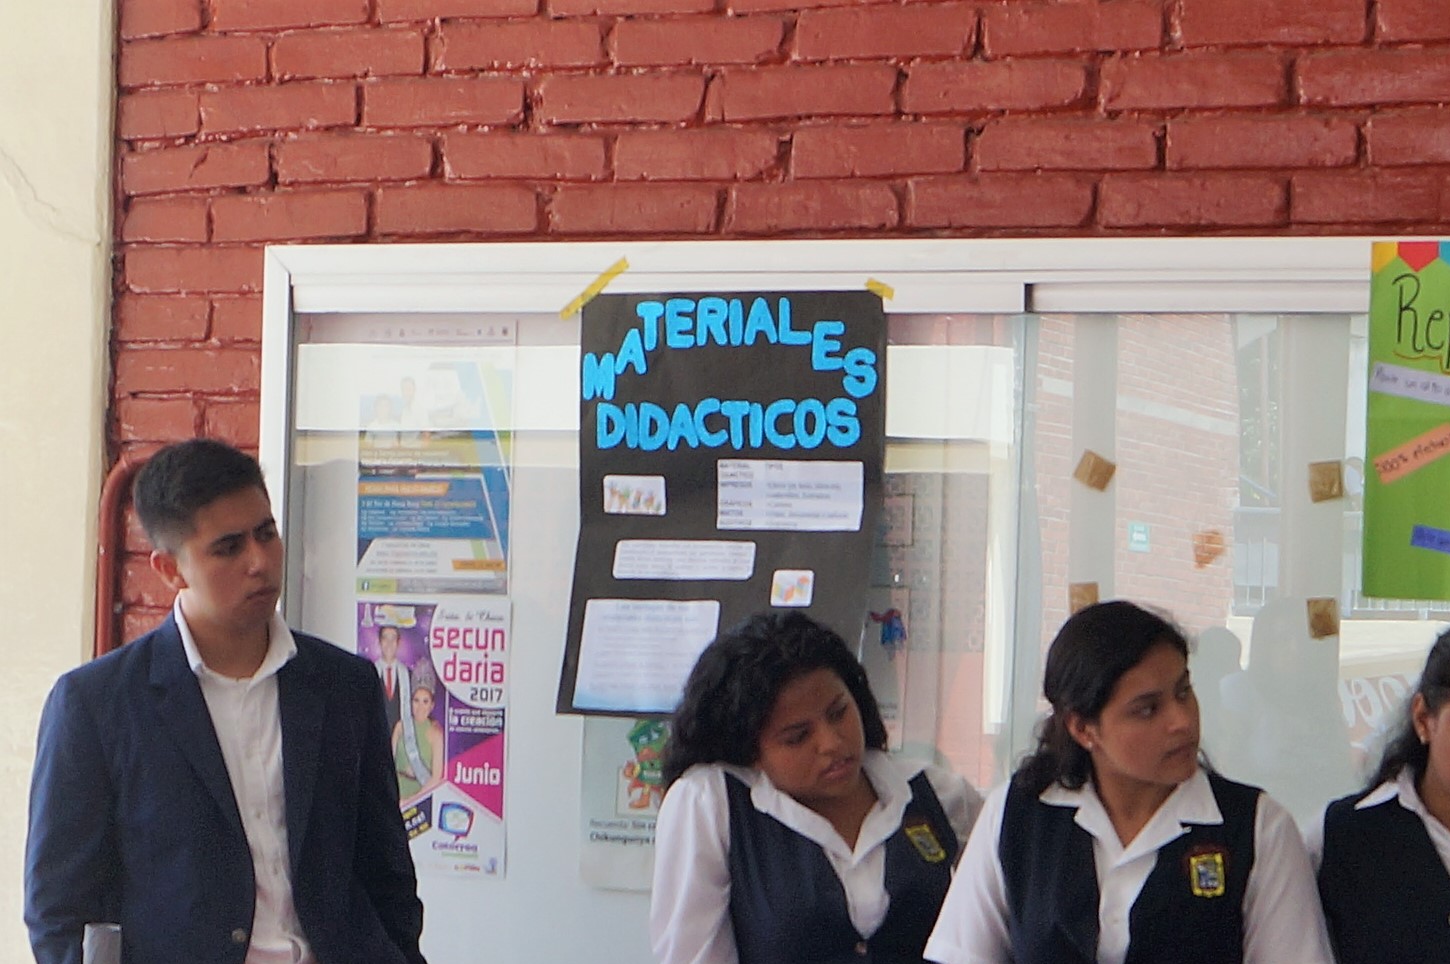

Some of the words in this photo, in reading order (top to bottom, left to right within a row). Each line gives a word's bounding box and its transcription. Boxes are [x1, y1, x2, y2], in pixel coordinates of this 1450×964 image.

[583, 296, 877, 400] MATERIALES
[597, 397, 862, 451] DIDACTICOS
[431, 627, 505, 651] secun
[444, 651, 504, 684] daria
[470, 686, 503, 703] 2017
[454, 761, 501, 786] Junio
